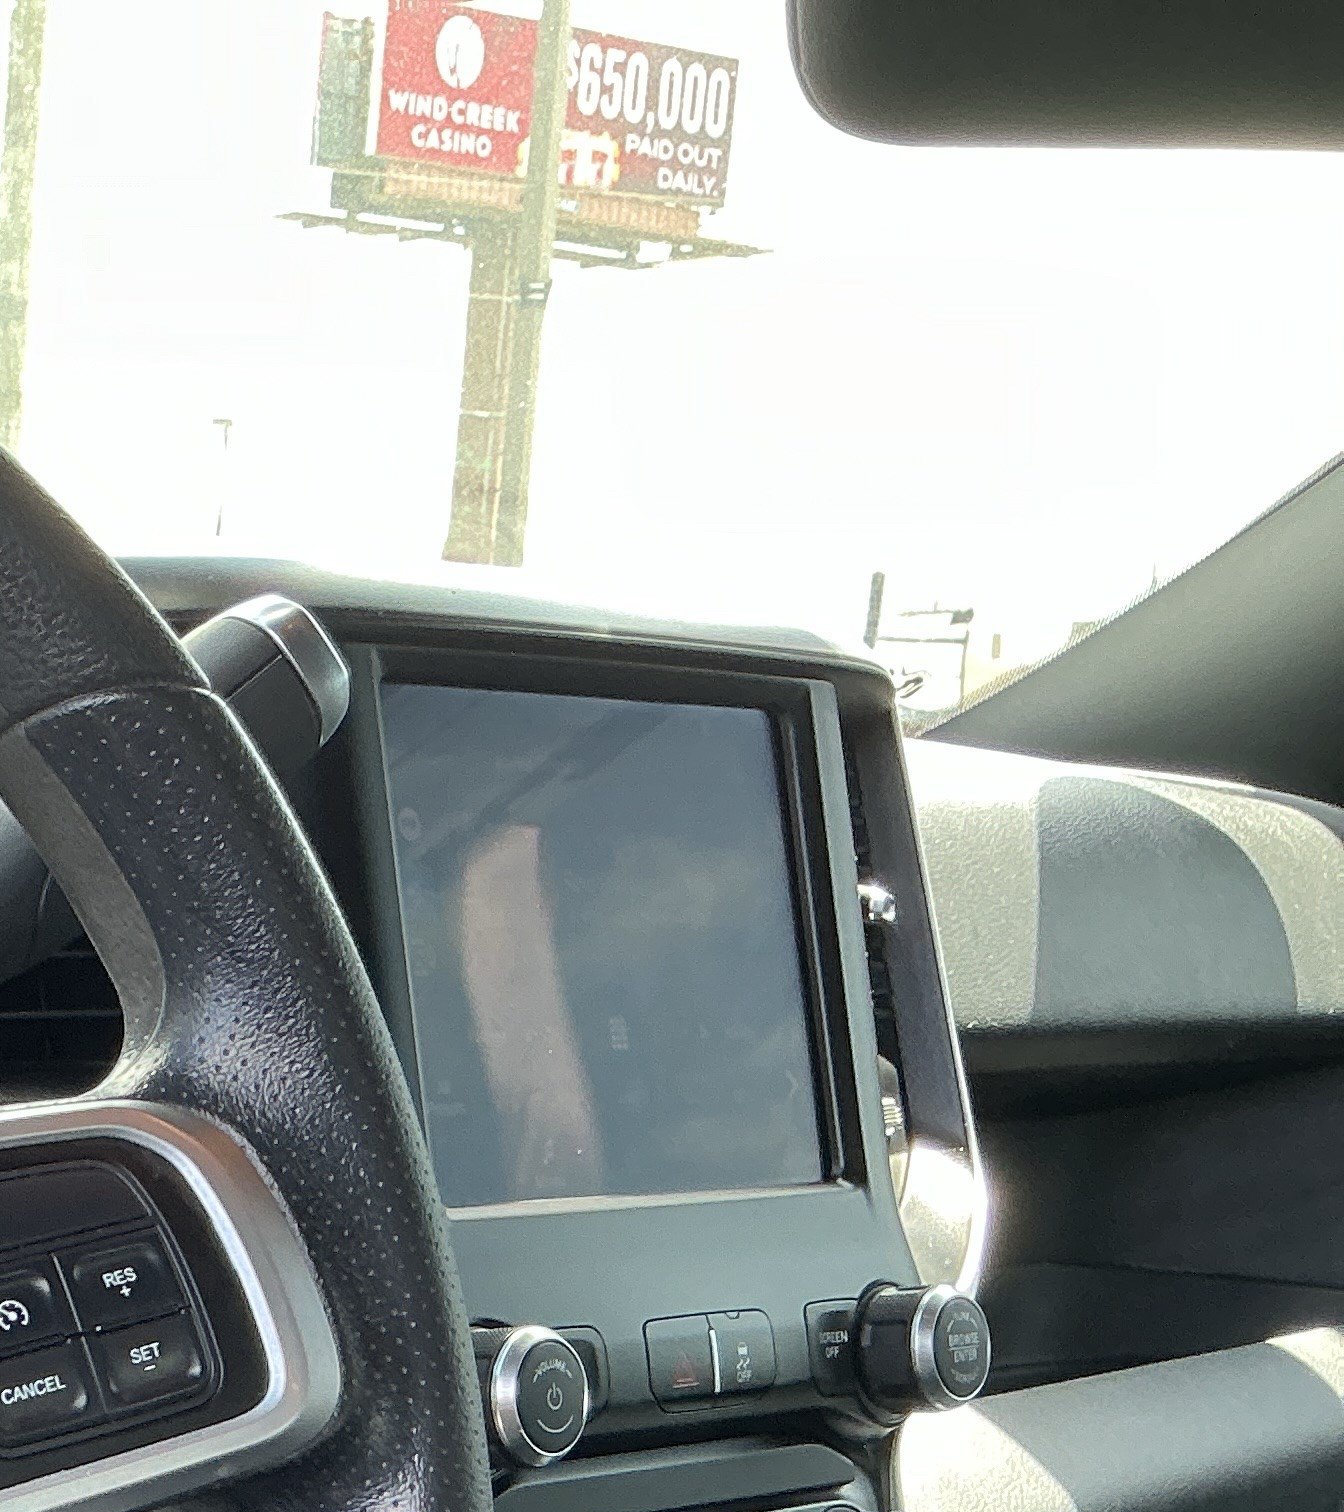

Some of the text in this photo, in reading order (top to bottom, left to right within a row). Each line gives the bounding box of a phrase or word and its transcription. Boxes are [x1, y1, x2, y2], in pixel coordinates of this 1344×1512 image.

[388, 89, 521, 133] WIND CREEK
[411, 123, 492, 158] CASINO
[625, 133, 674, 160] PAID
[677, 142, 722, 169] OUT
[102, 1267, 137, 1288] RES
[130, 1342, 160, 1364] SET
[825, 1346, 840, 1359] OFF
[0, 1375, 66, 1405] CANCEL
